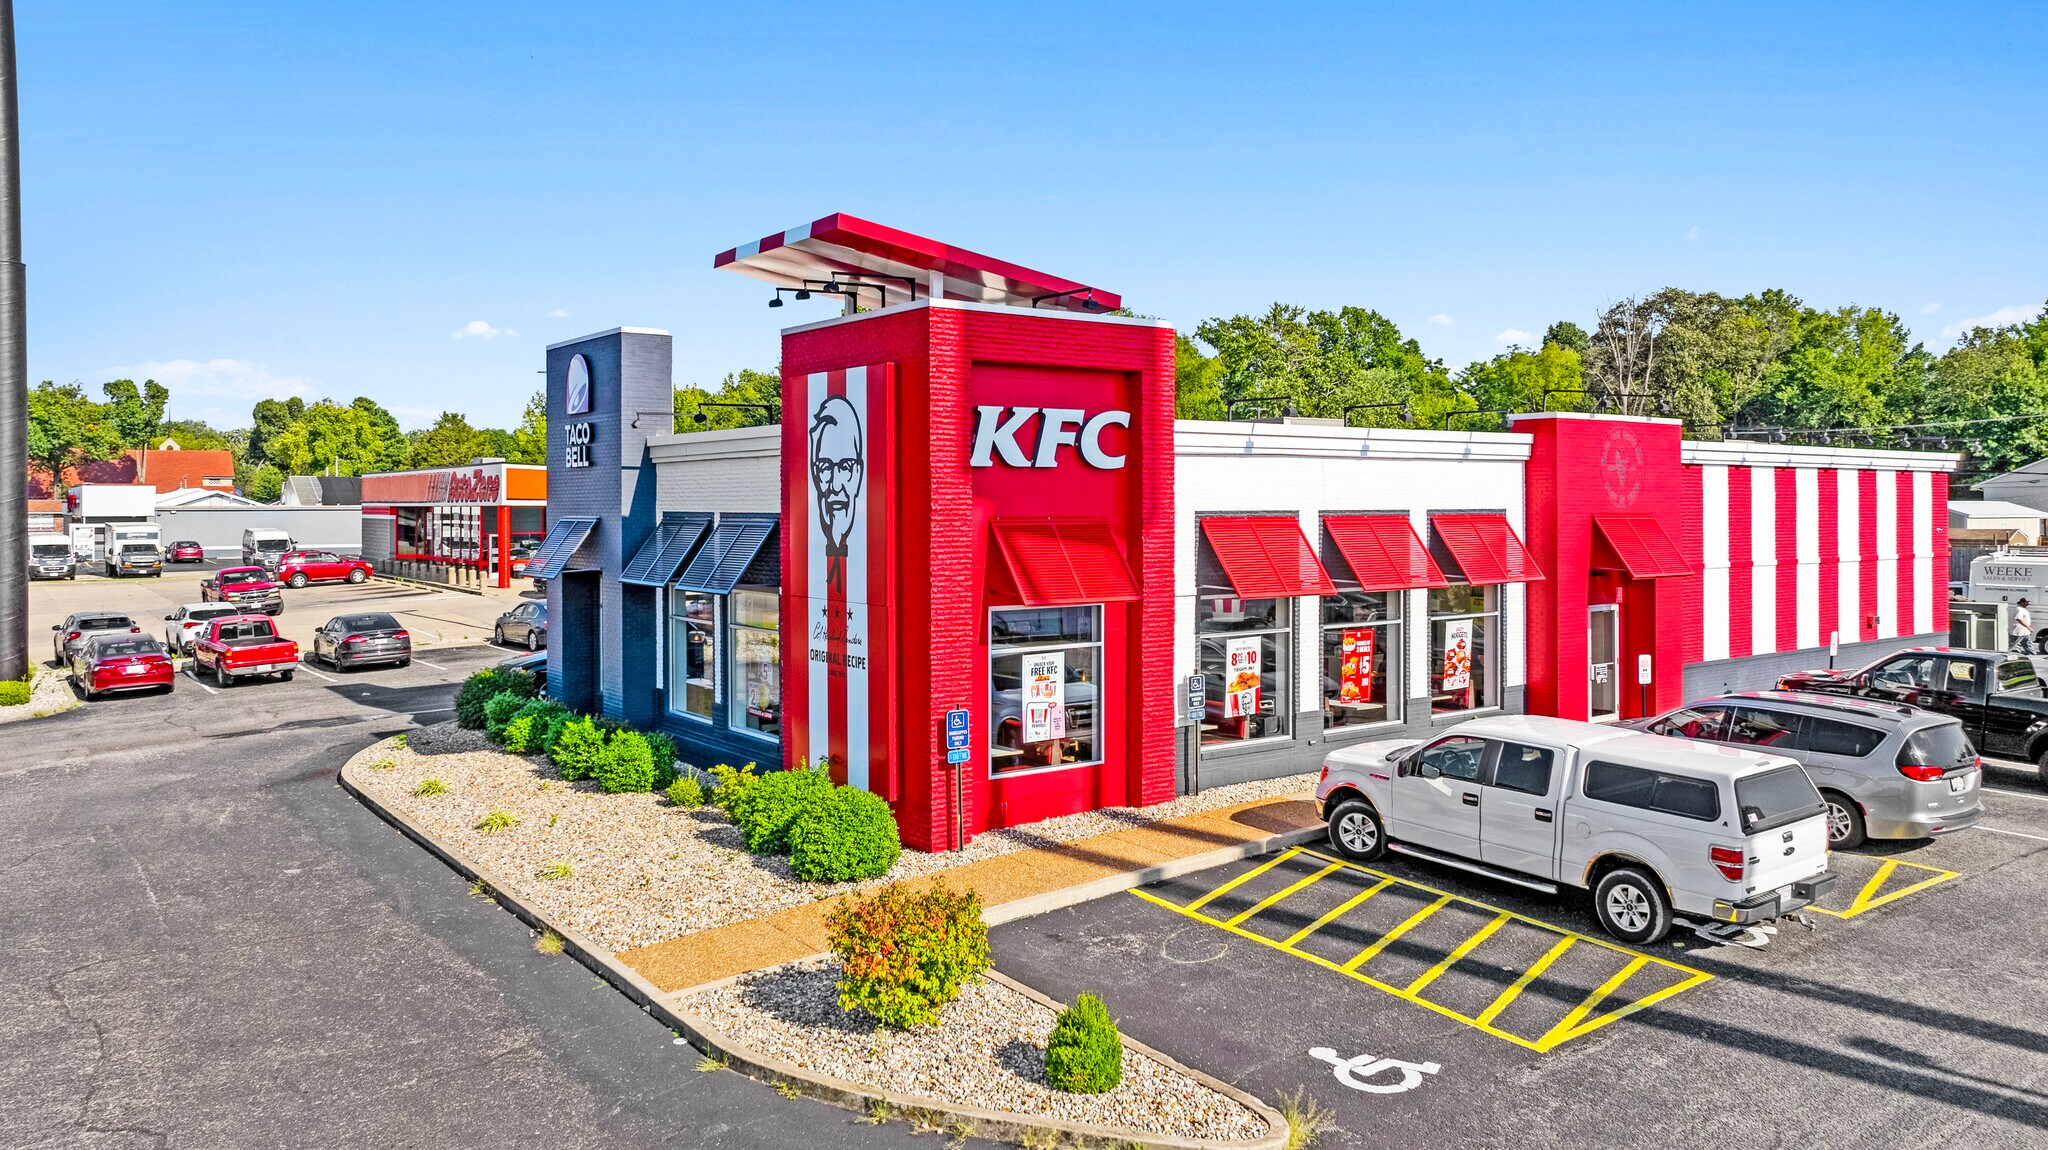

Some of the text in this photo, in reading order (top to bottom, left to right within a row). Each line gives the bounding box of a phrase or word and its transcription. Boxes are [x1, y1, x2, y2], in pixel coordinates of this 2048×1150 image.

[565, 422, 590, 445] TACO
[970, 405, 1131, 470] KFC
[566, 446, 589, 468] BELL
[449, 469, 500, 503] AutoZone
[1984, 567, 2033, 577] WEEKE
[1451, 631, 1468, 639] NUGGETS
[810, 648, 866, 670] ORIGINAL RECIPE
[1231, 652, 1237, 666] 8
[1359, 655, 1370, 675] $5
[1031, 665, 1058, 676] FREE KFC
